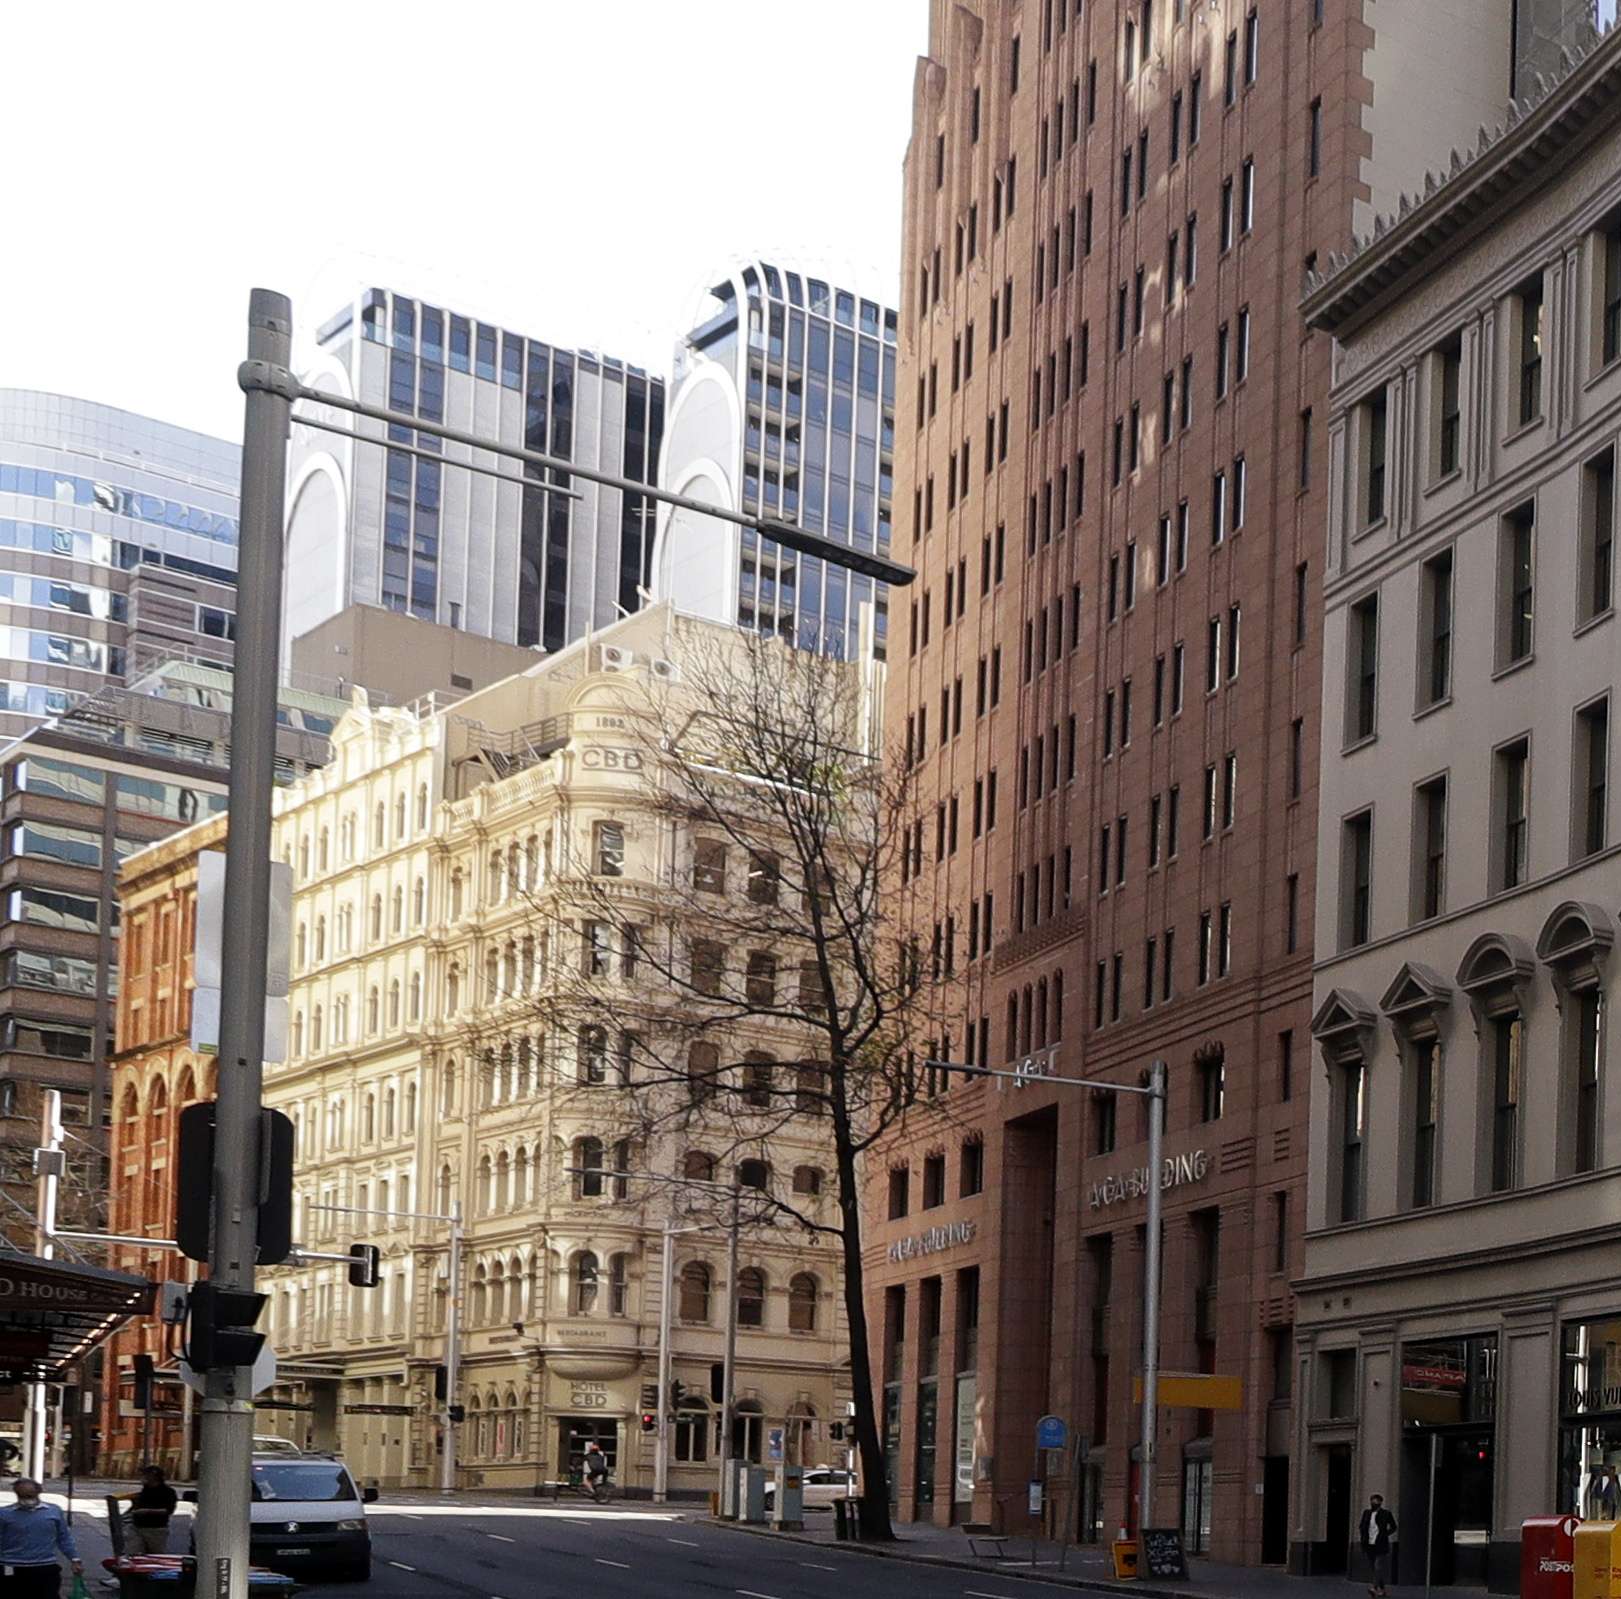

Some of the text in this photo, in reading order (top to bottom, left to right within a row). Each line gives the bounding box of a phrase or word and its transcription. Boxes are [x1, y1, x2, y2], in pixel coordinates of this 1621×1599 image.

[582, 749, 642, 770] CBD
[1130, 1149, 1208, 1198] BUDING
[19, 1280, 88, 1302] HOUSE
[570, 1381, 607, 1392] HOTEL
[570, 1393, 608, 1407] CBD
